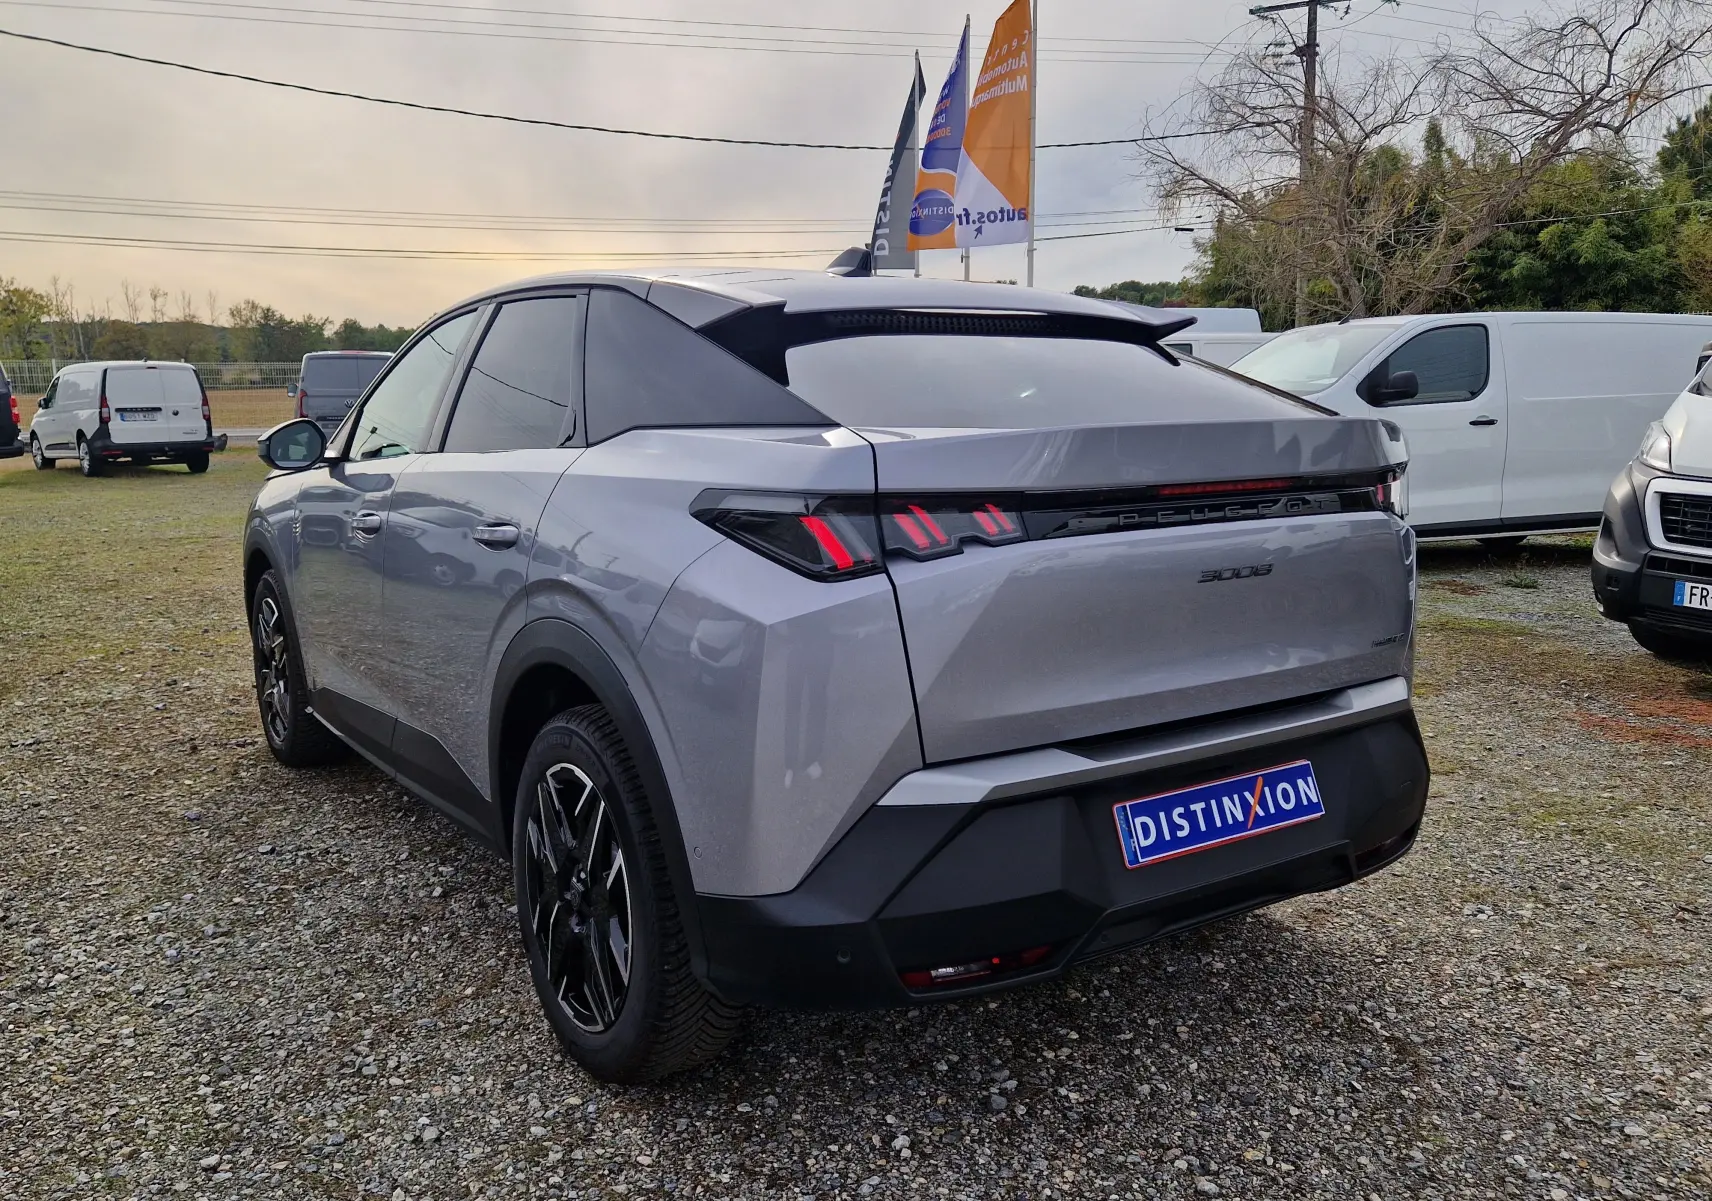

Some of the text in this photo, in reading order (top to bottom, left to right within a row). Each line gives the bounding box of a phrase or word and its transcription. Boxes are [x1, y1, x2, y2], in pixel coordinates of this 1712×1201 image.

[1119, 500, 1330, 526] PEUGEOT
[1197, 563, 1274, 583] 3008
[1134, 776, 1319, 848] DISTINXION
